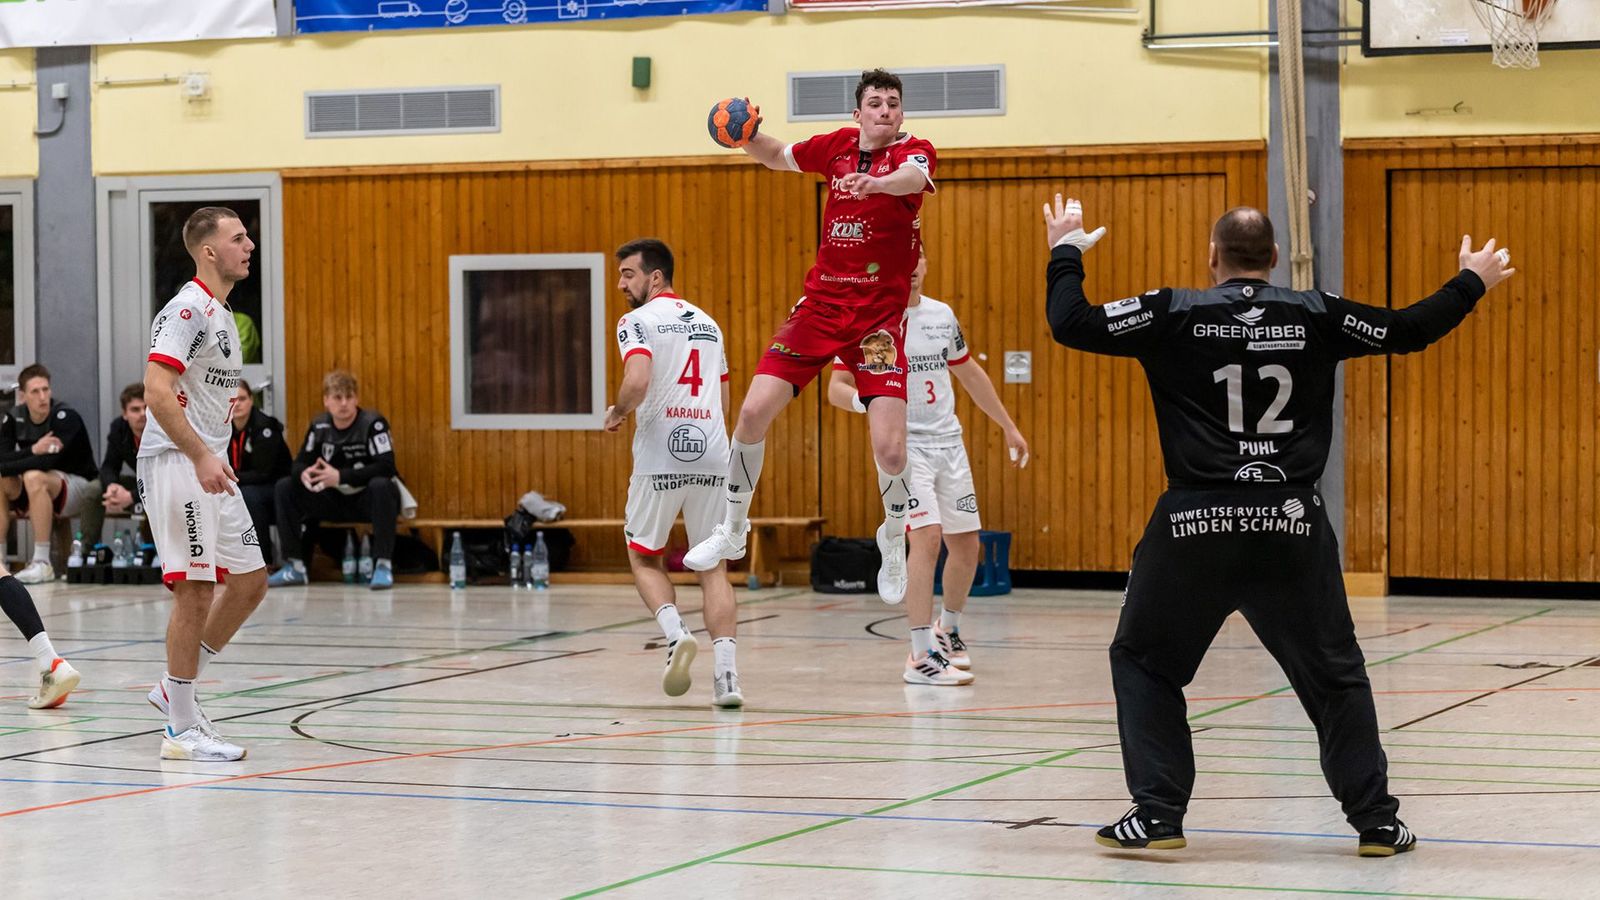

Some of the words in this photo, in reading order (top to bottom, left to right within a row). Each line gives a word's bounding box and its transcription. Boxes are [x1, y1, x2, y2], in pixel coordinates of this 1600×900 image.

[831, 222, 864, 238] KDE
[1107, 310, 1154, 332] BUCOLIN
[1343, 314, 1388, 340] pmd
[1193, 323, 1306, 339] GREENFIBER
[907, 353, 941, 363] LTSERVICE
[677, 348, 703, 397] 4
[907, 361, 946, 373] DENSCHM
[924, 380, 936, 404] 3
[1212, 363, 1294, 434] 12
[223, 397, 239, 424] 7
[666, 407, 712, 420] KARAULA
[1238, 440, 1279, 456] PUHL
[1169, 506, 1278, 523] UMWELTSERVICE
